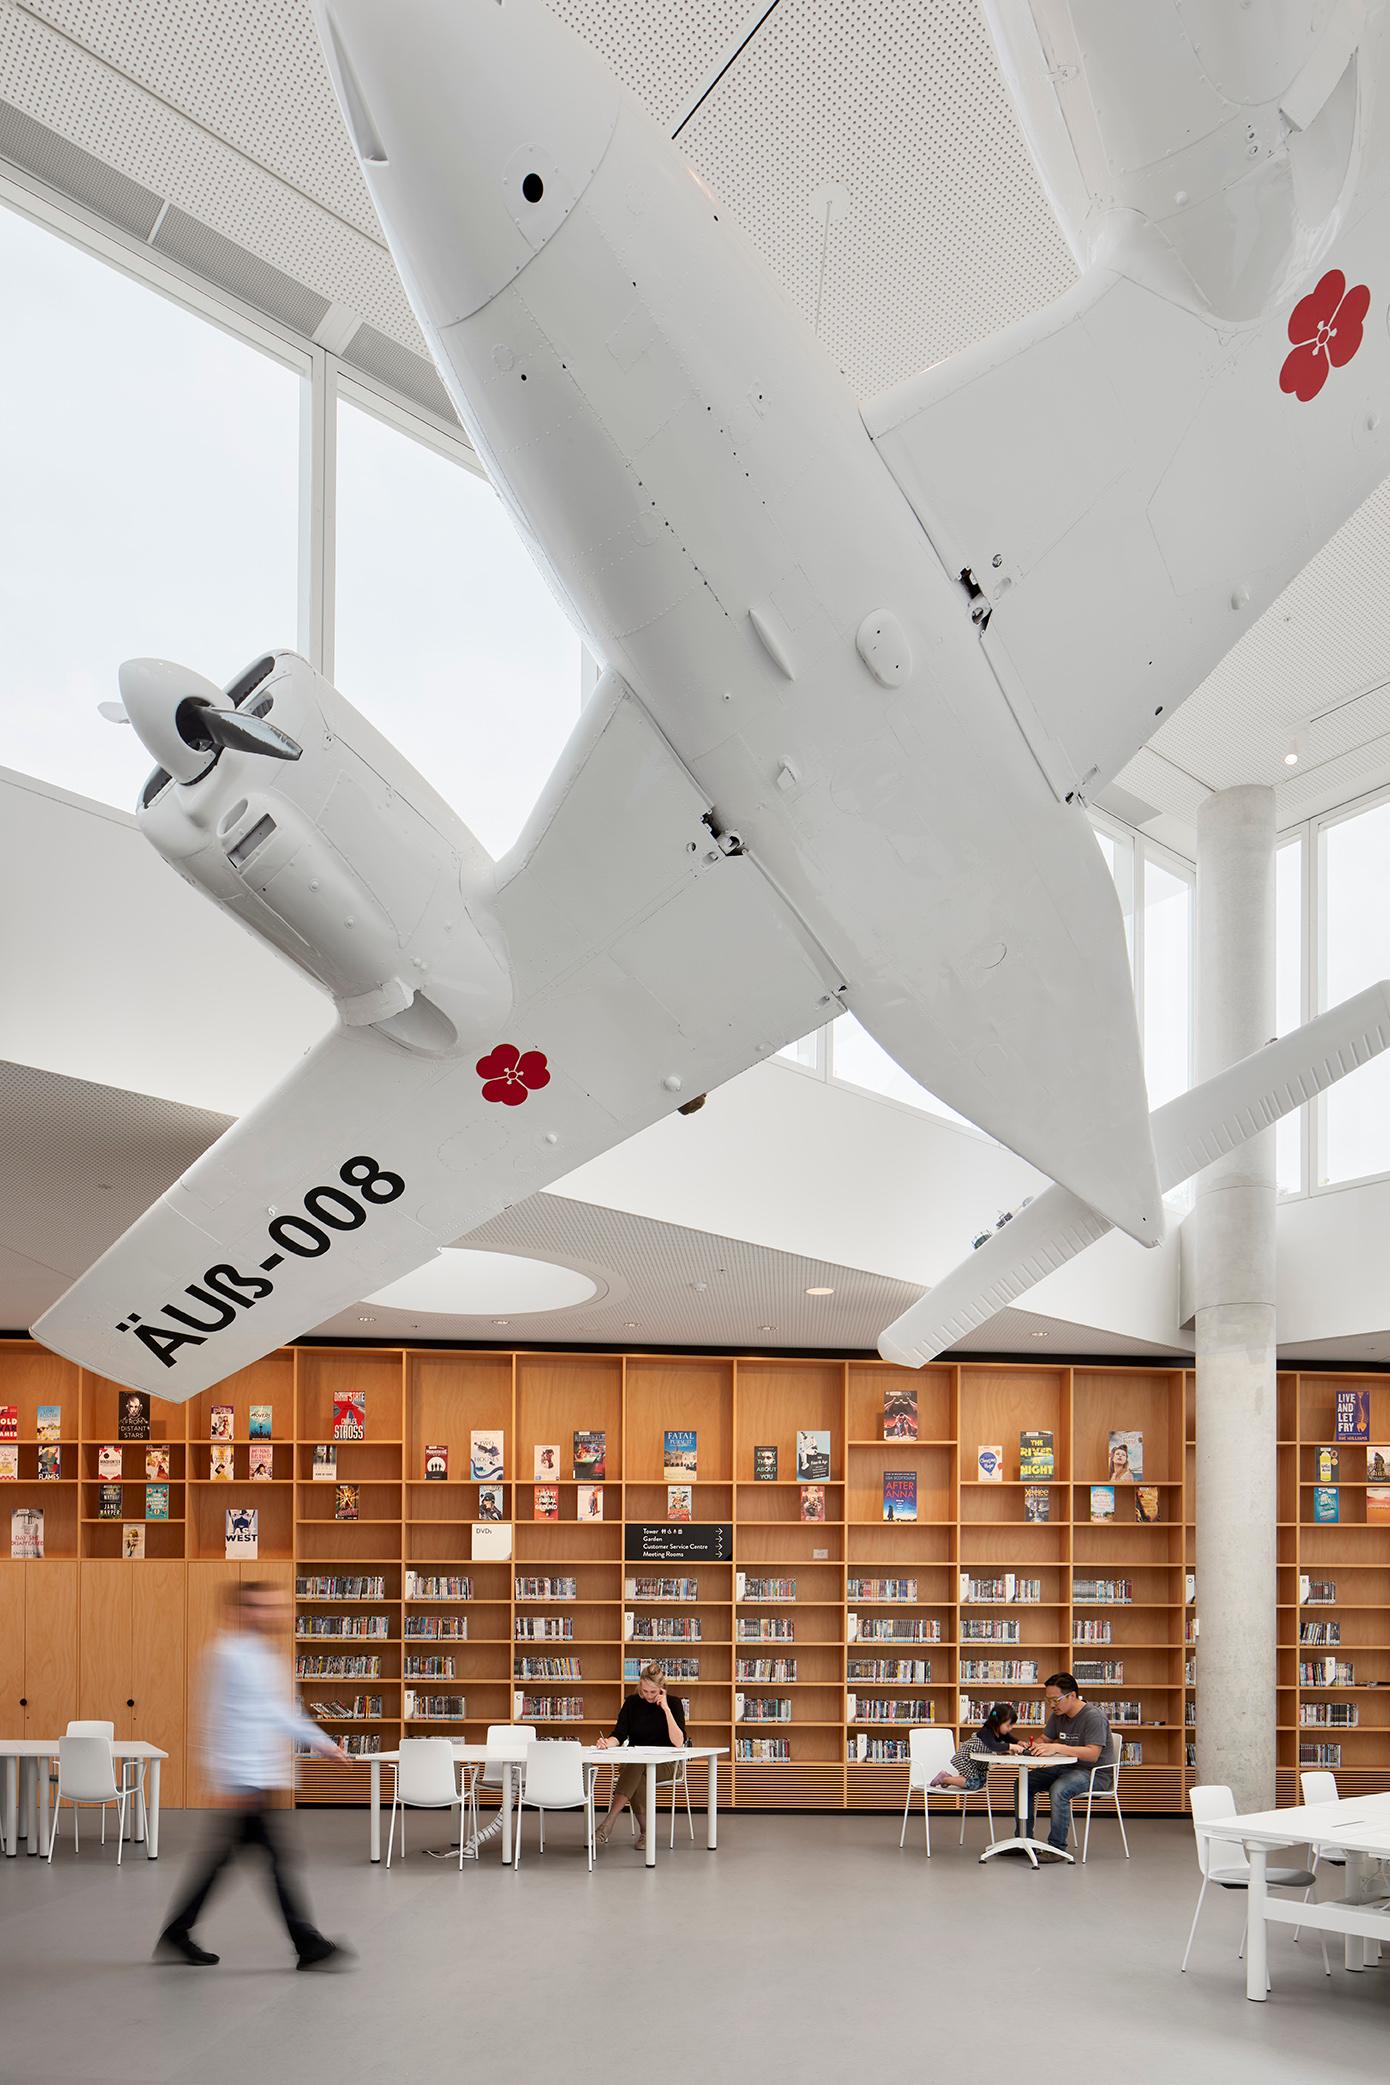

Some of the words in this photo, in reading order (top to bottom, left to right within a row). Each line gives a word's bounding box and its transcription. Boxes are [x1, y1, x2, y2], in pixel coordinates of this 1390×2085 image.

[1338, 1394, 1356, 1403] LIVE
[1337, 1403, 1354, 1412] AND
[1338, 1413, 1354, 1422] LET
[1338, 1423, 1355, 1432] FRY
[334, 1425, 363, 1440] STROSS
[668, 1432, 694, 1440] FATAL
[1020, 1447, 1053, 1456] RIVER
[1020, 1465, 1054, 1475] NIGHT
[885, 1481, 915, 1490] AFTER
[885, 1490, 915, 1498] ANNA
